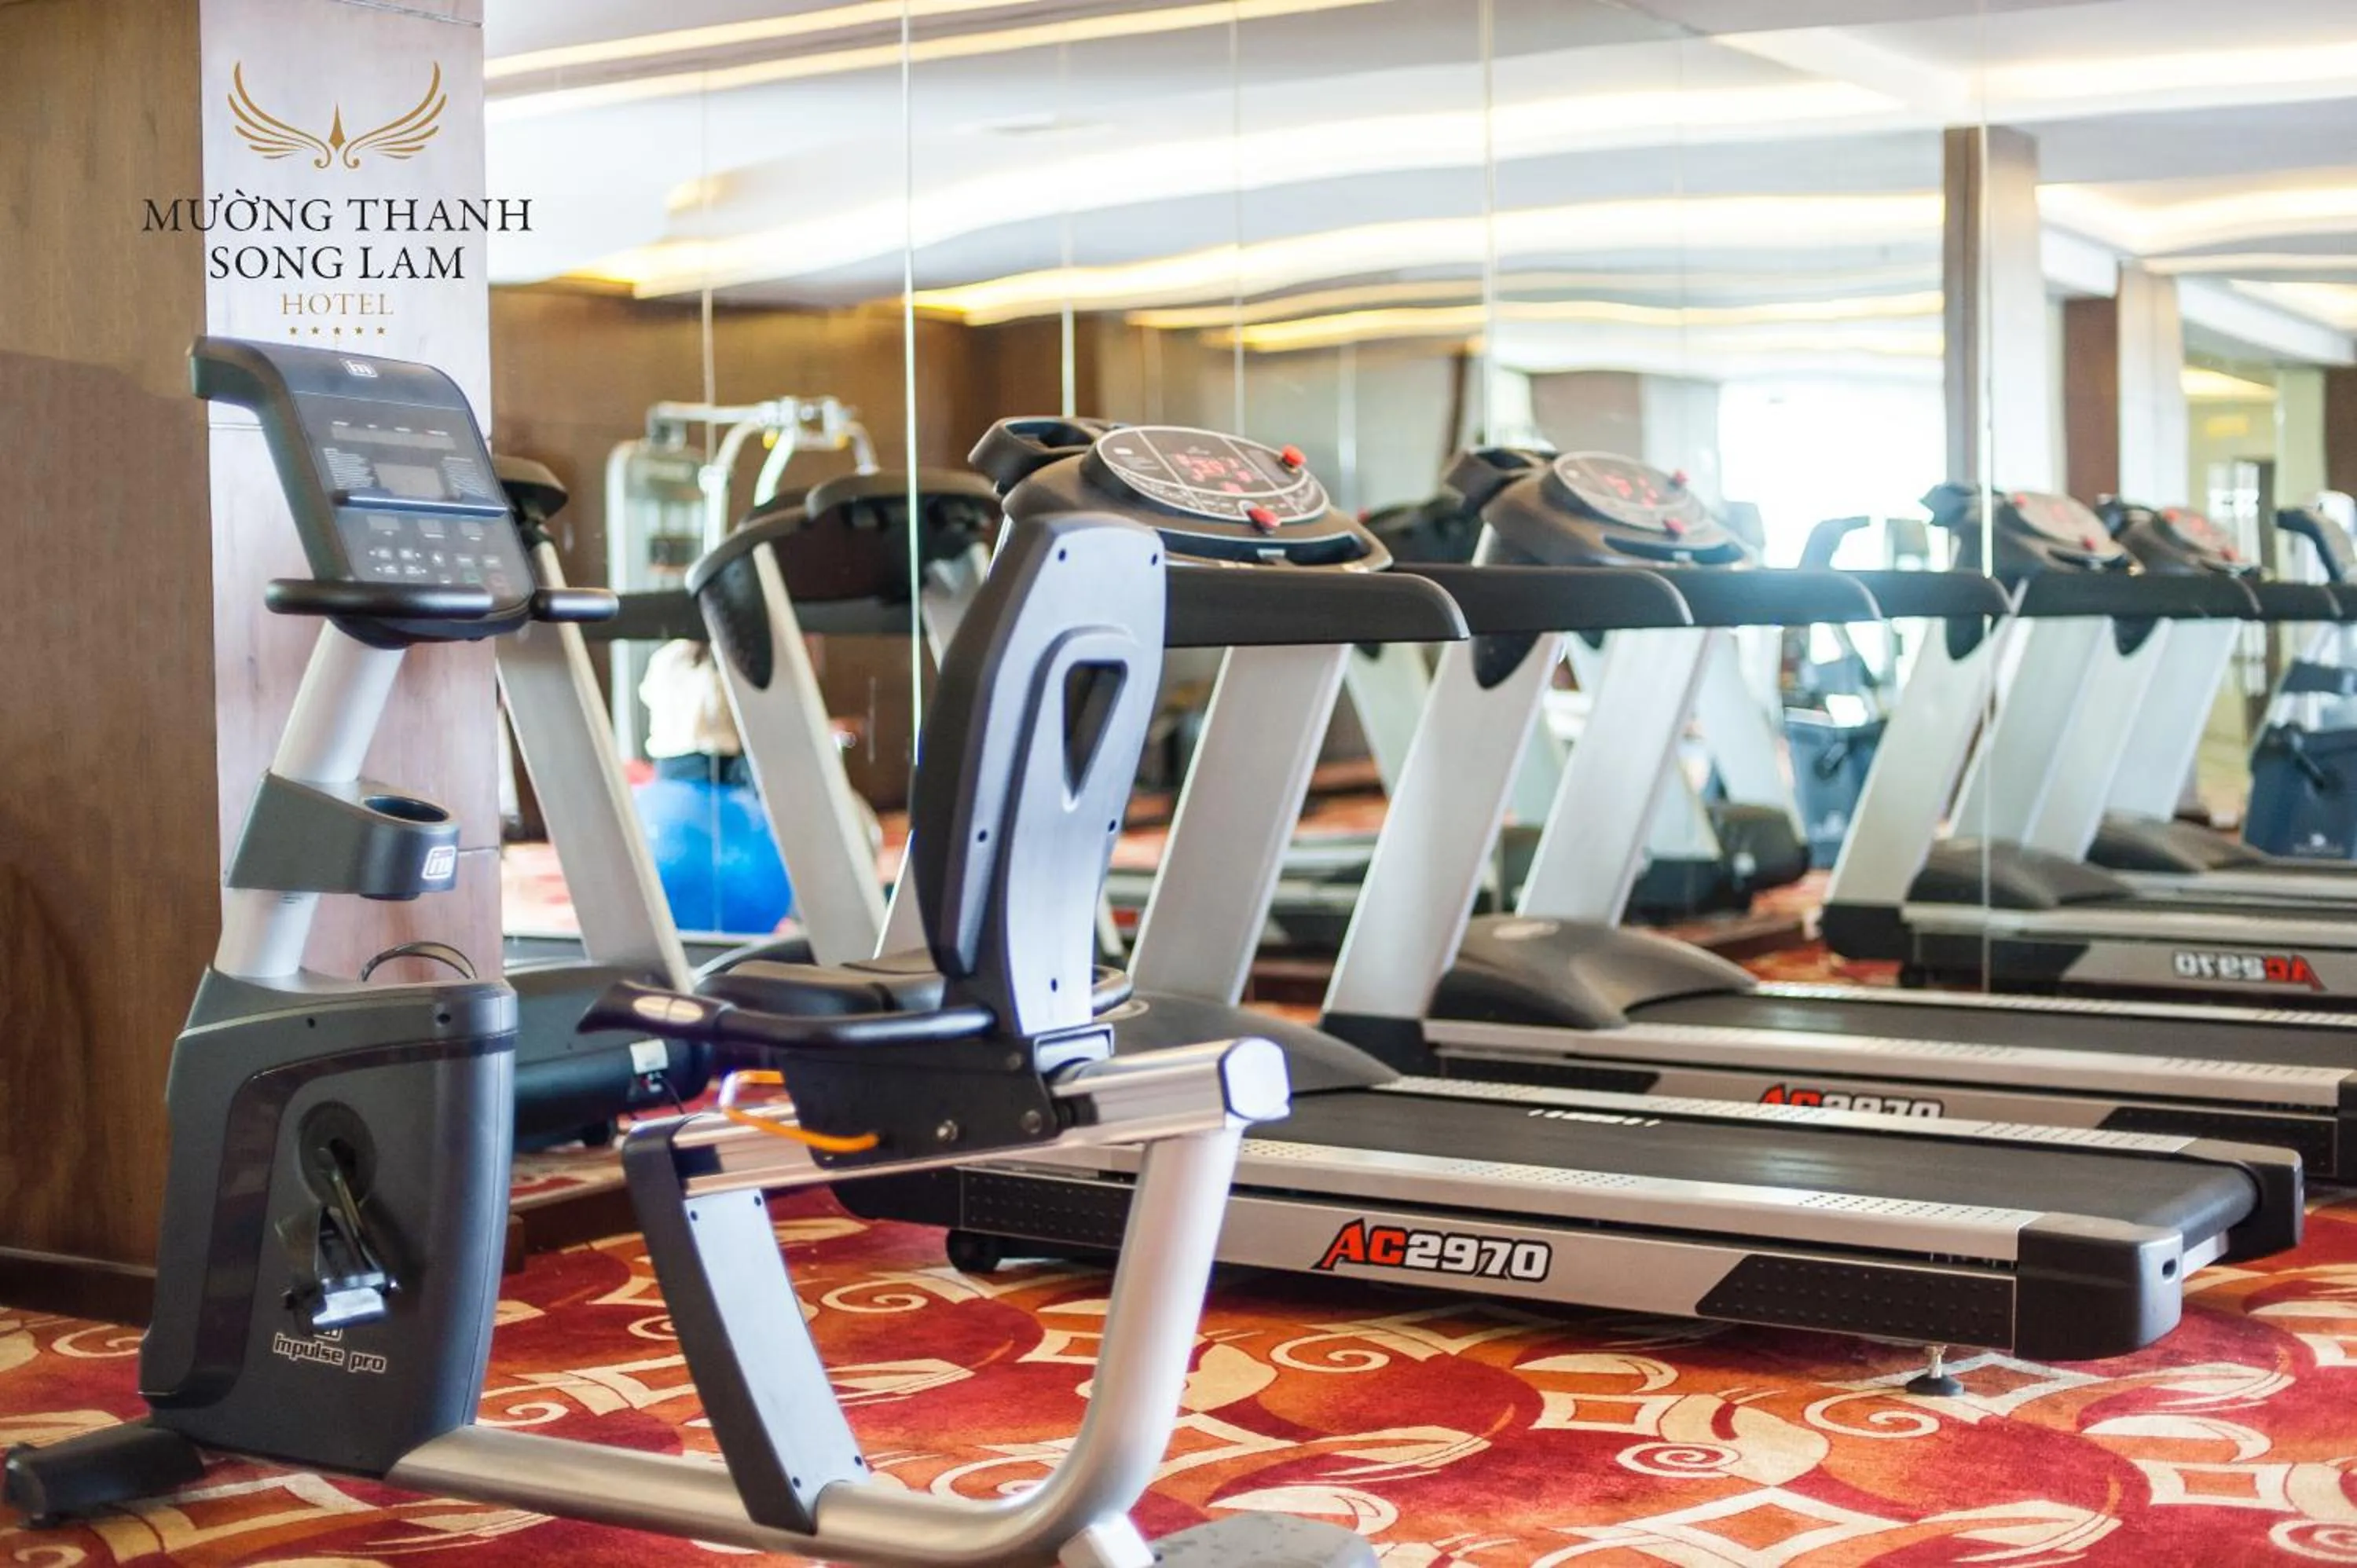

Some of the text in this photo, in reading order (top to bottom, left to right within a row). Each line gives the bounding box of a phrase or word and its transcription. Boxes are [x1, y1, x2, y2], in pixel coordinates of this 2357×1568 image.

[1311, 1218, 1552, 1282] AC2970
[273, 1332, 345, 1365] impulse
[348, 1351, 387, 1373] pro
